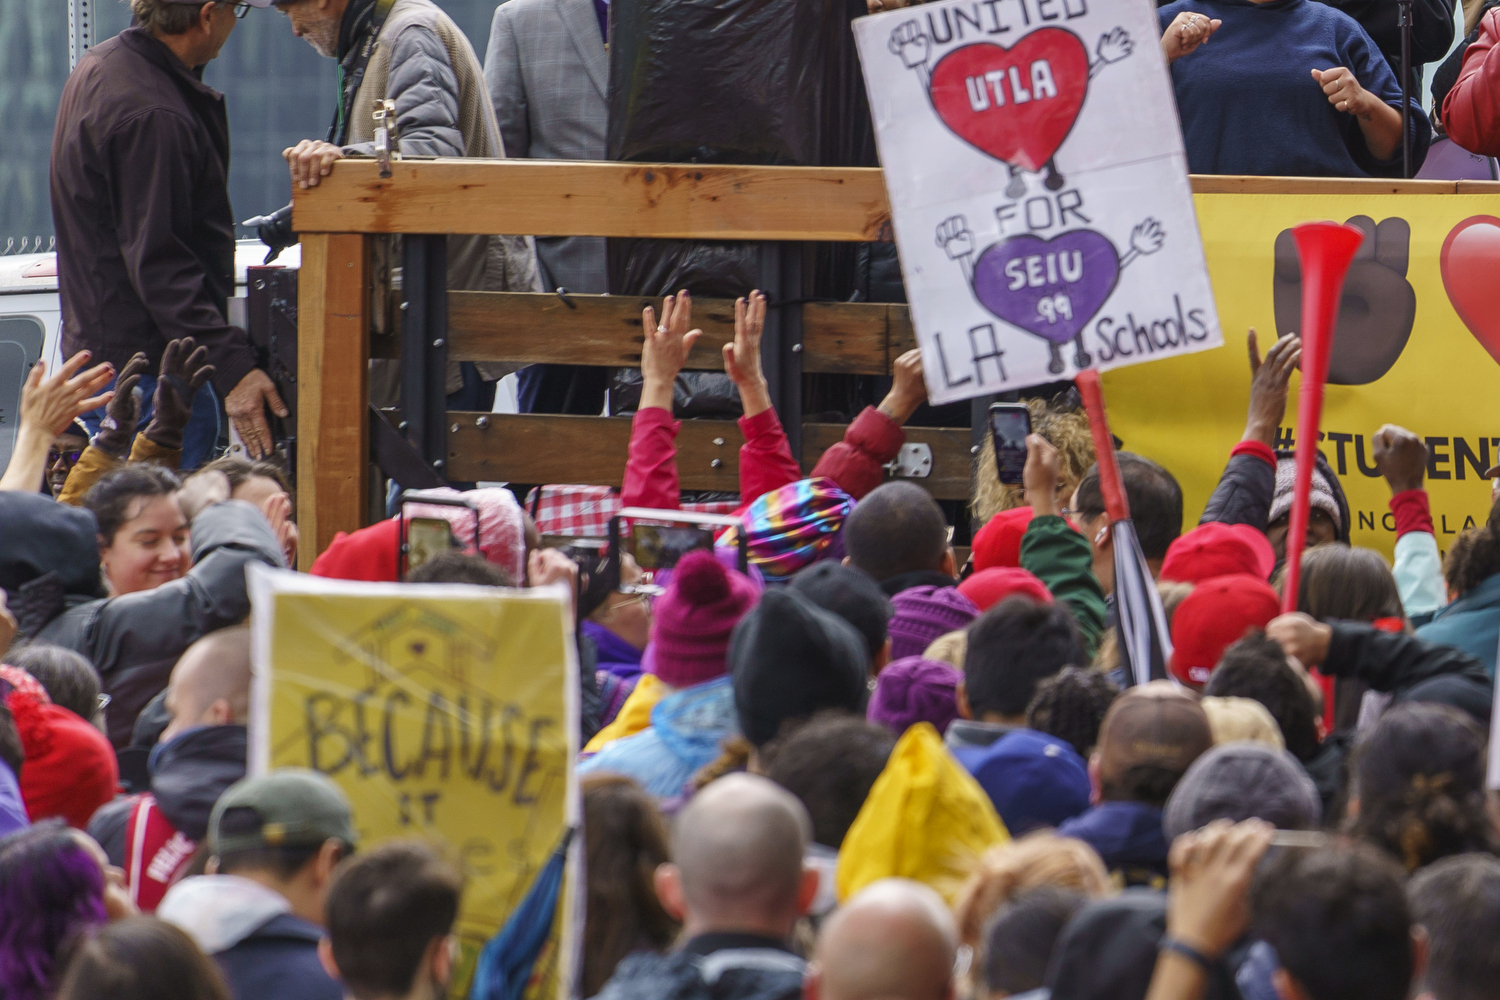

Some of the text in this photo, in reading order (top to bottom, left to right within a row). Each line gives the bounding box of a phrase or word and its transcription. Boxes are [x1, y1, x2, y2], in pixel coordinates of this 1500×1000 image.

[964, 59, 1058, 112] UTLA
[995, 188, 1092, 235] FOR
[1005, 250, 1083, 292] SEIU
[1036, 294, 1073, 324] 99
[933, 293, 1210, 389] LA Schools
[305, 686, 557, 807] BECAUSE
[398, 793, 442, 825] IT
